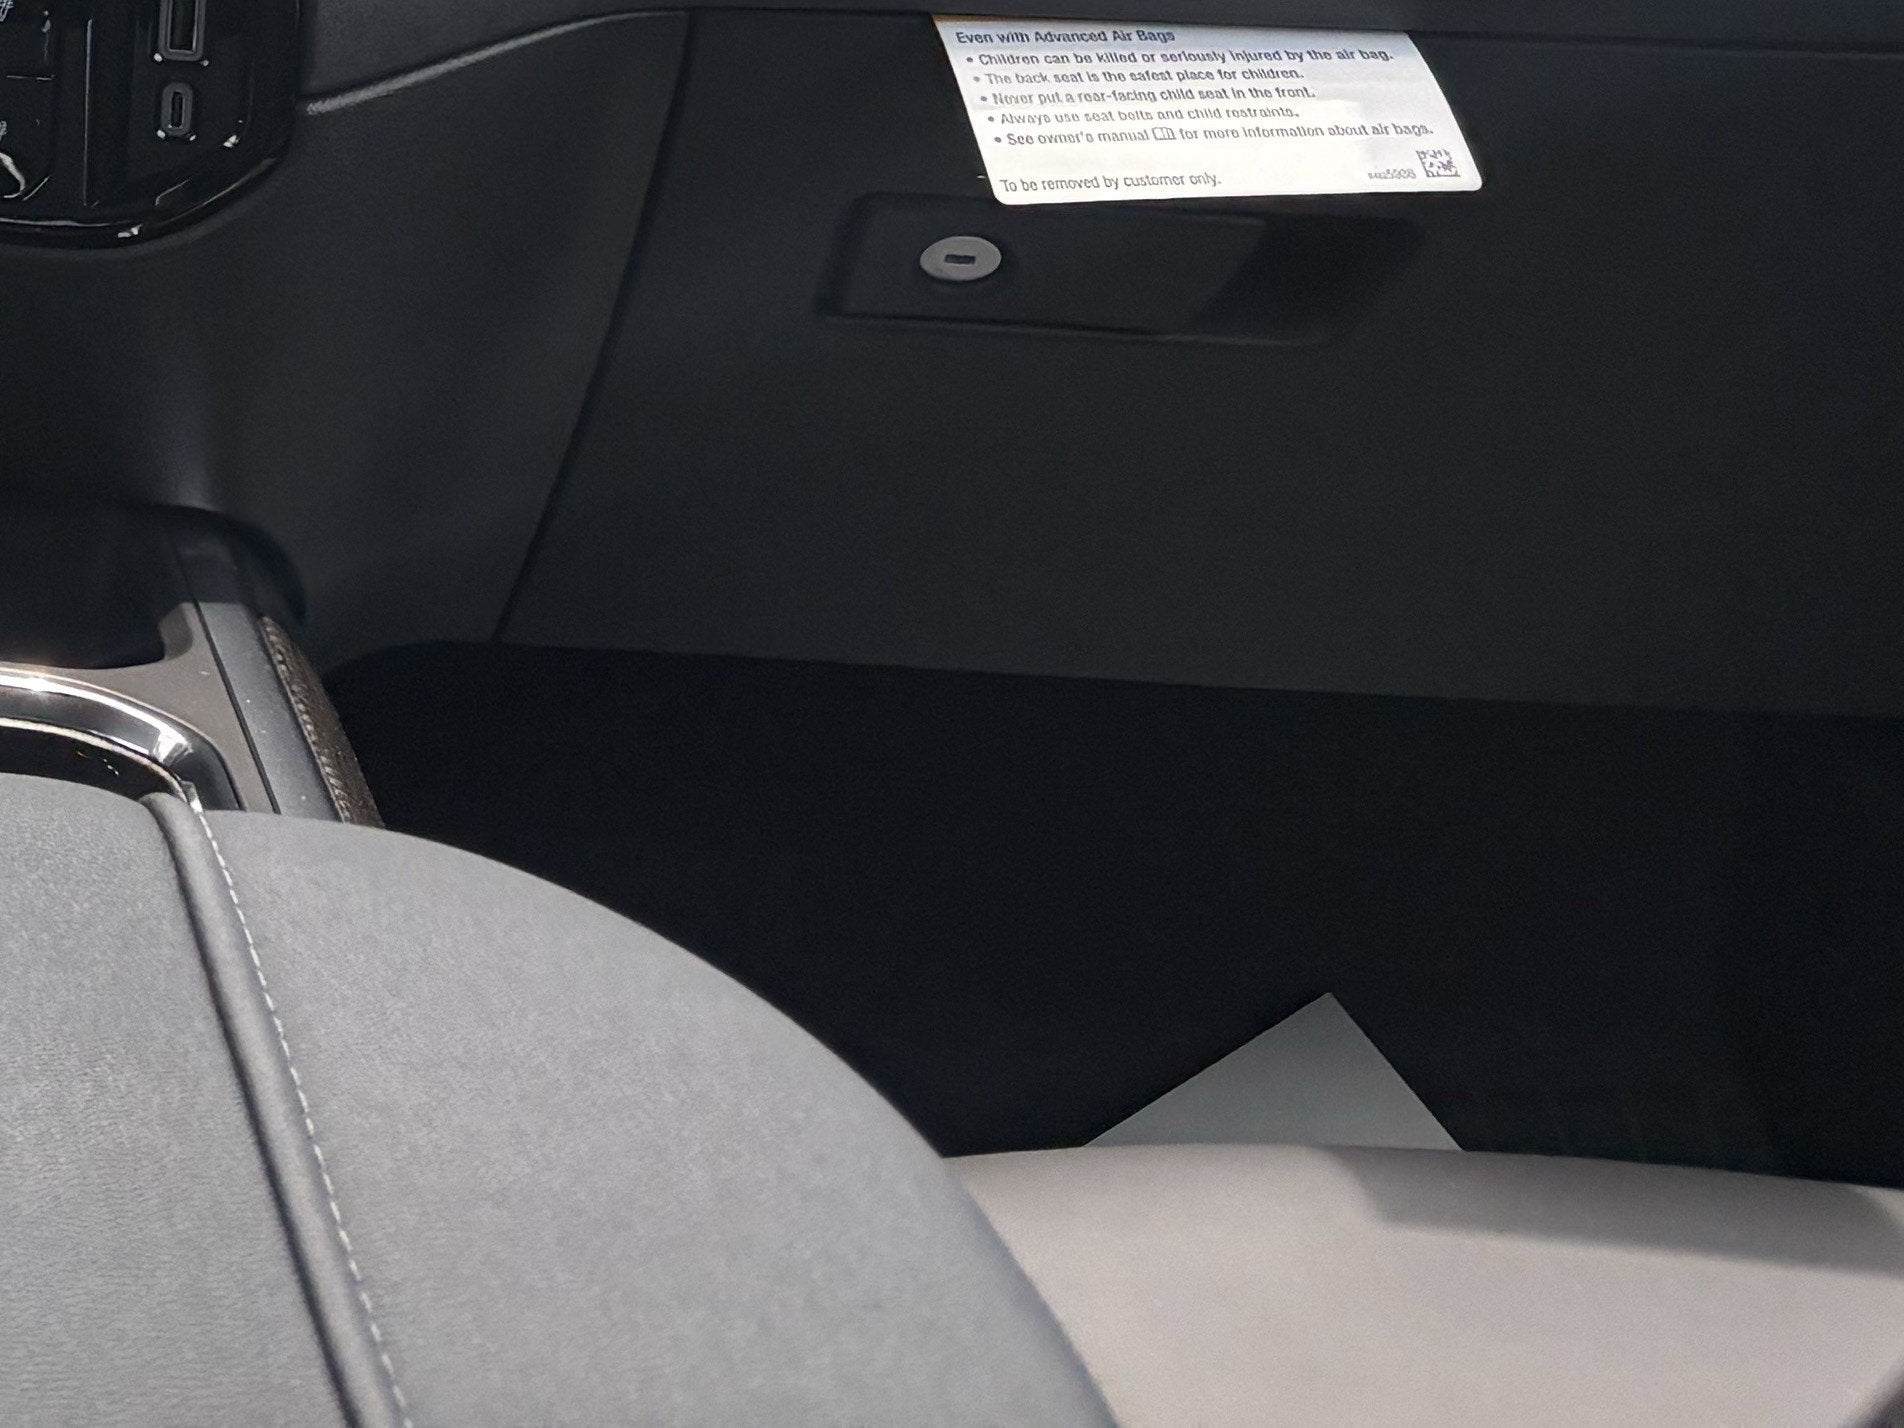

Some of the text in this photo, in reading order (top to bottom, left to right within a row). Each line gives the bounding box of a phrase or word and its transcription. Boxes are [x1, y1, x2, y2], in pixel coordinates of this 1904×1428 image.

[956, 30, 1176, 44] Even with Advanced Air Bags
[979, 48, 1394, 66] Children can be killed or seriously injured by the air bag.
[985, 67, 1304, 85] The back seat is the safest place for children.
[992, 86, 1316, 105] Never put a rear-facing child seat in the front.
[1001, 106, 1300, 126] Always use seat belts and child restraints.
[1007, 122, 1434, 145] See owner's manual for more information about air bags.
[1000, 171, 1222, 192] To be removed by customer only.
